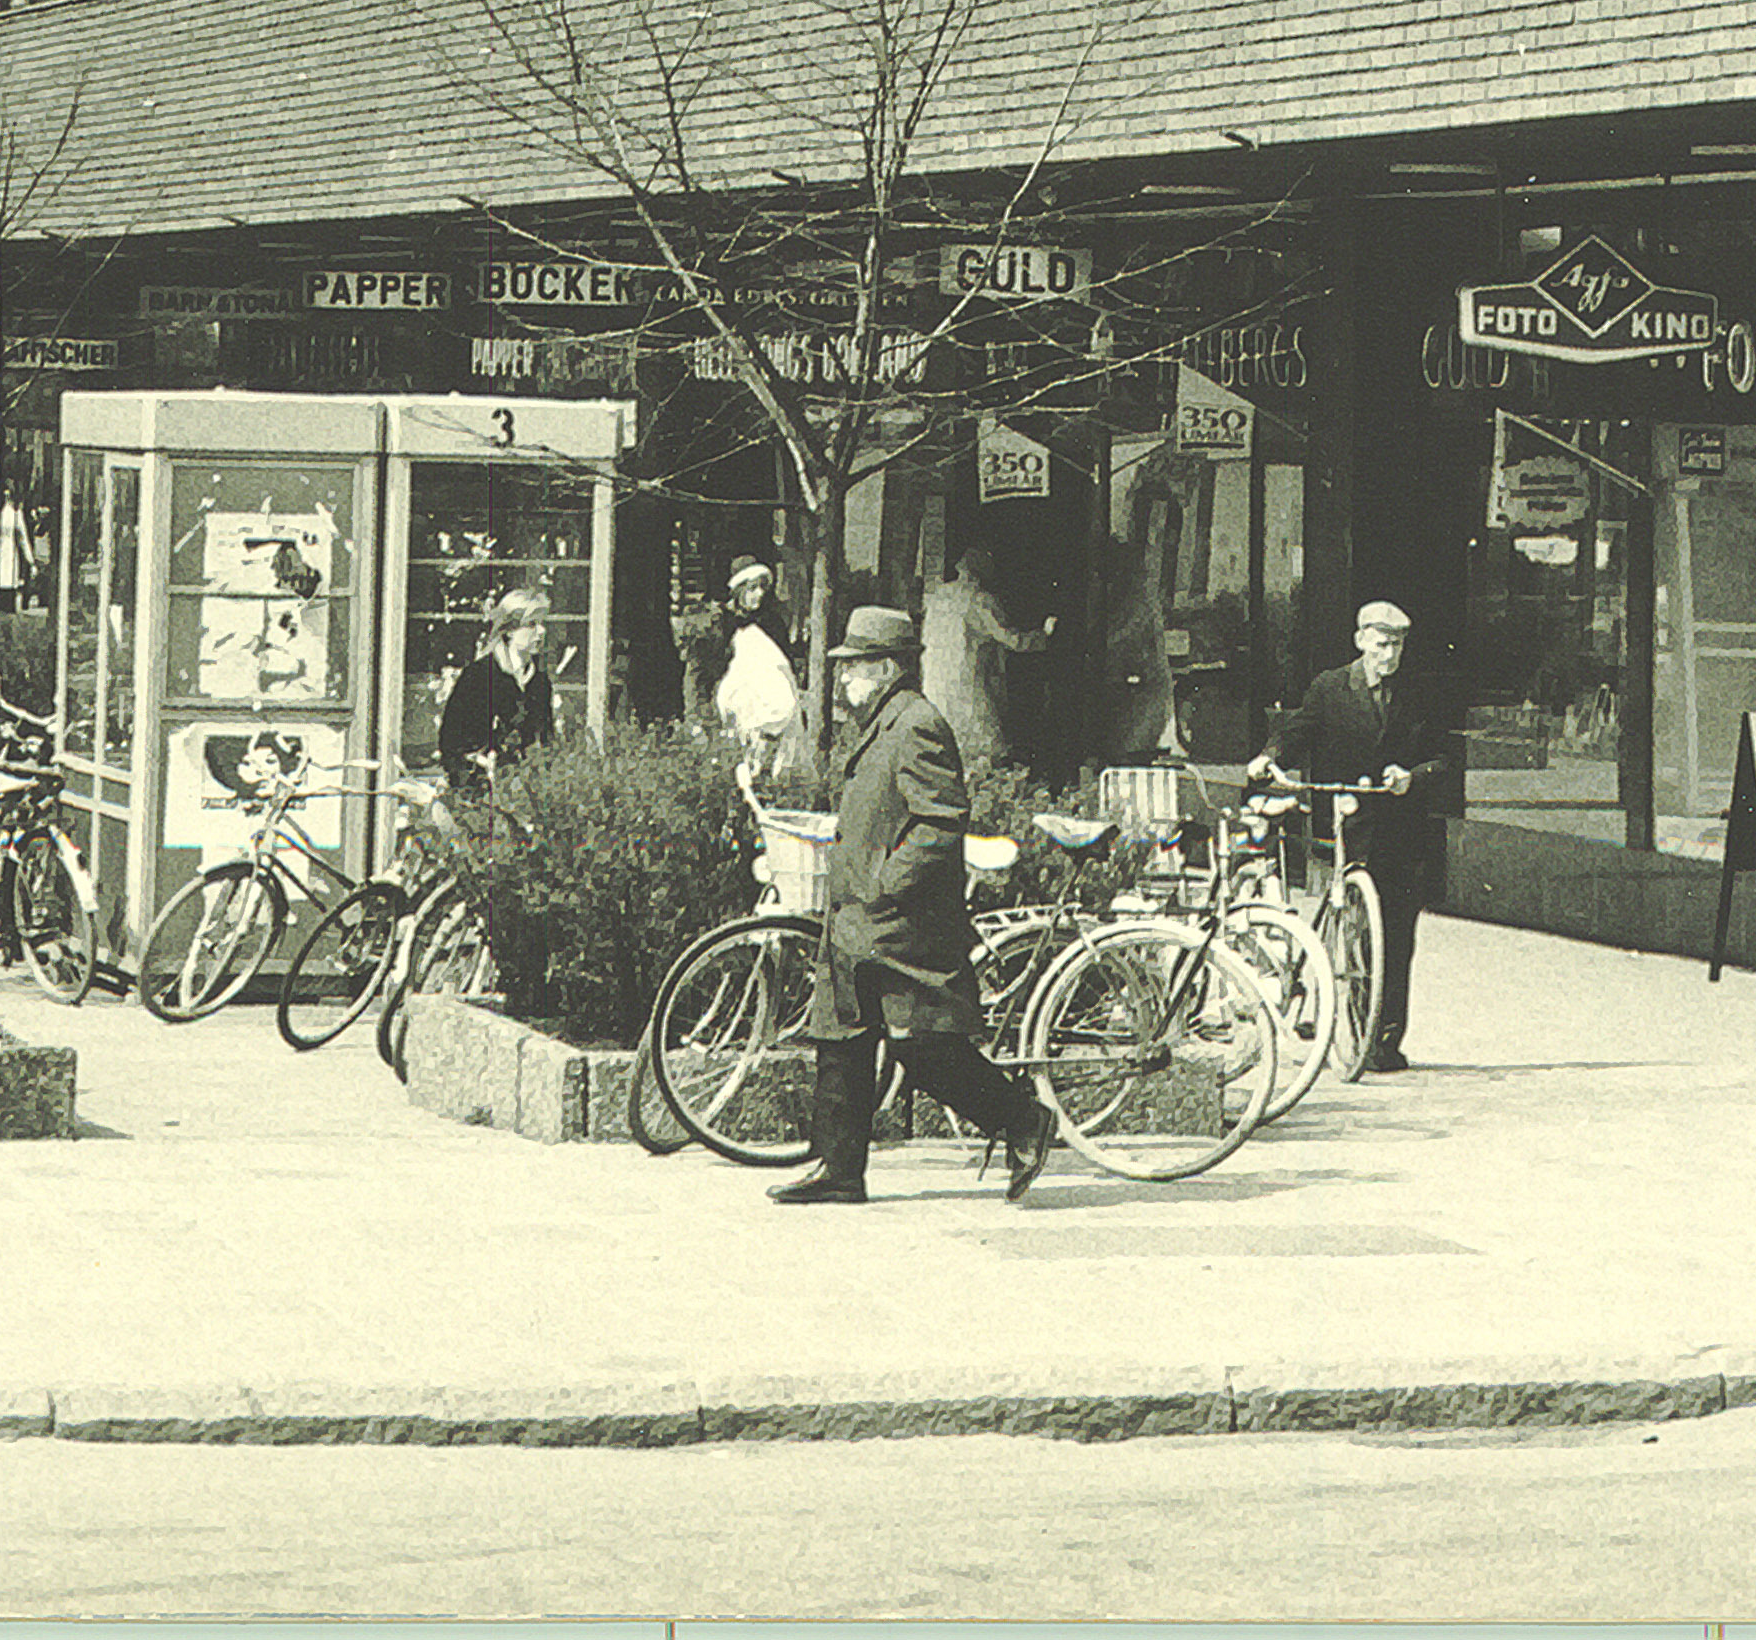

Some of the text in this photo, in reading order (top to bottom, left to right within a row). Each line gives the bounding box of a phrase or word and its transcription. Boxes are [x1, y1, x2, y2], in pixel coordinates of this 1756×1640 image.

[491, 264, 635, 303] BÖCKER
[957, 248, 1077, 293] GULD
[1550, 261, 1631, 313] Agfa
[306, 273, 449, 308] PAPPER
[1477, 305, 1710, 340] FOTO KINO
[490, 408, 516, 447] 3
